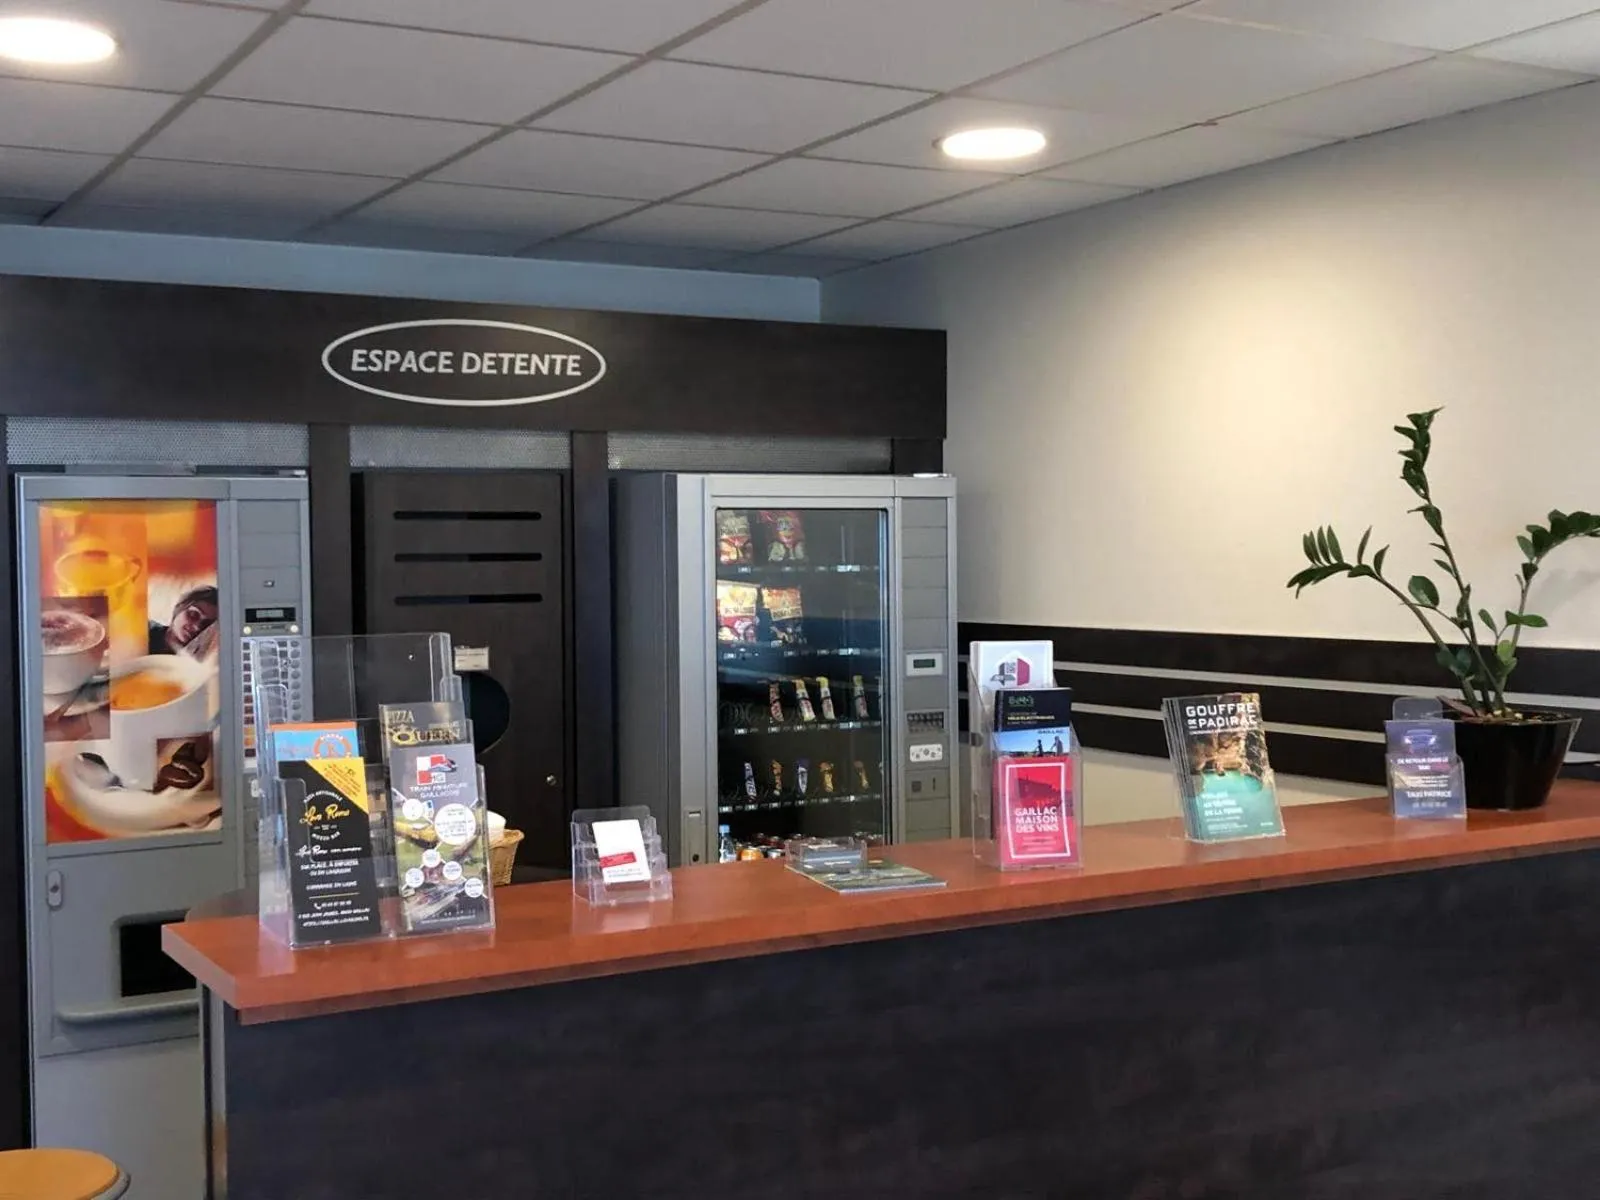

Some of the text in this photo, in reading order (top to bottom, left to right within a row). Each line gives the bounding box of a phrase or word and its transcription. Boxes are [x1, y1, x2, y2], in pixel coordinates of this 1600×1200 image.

[350, 348, 582, 377] ESPACE DETENTE
[385, 708, 415, 724] PIZZA
[1185, 702, 1257, 717] GOUFFRE
[1198, 714, 1258, 729] PADIRAC
[1014, 806, 1057, 817] GAILLAC
[1015, 815, 1058, 825] MAISON
[1015, 822, 1059, 833] DES VINS
